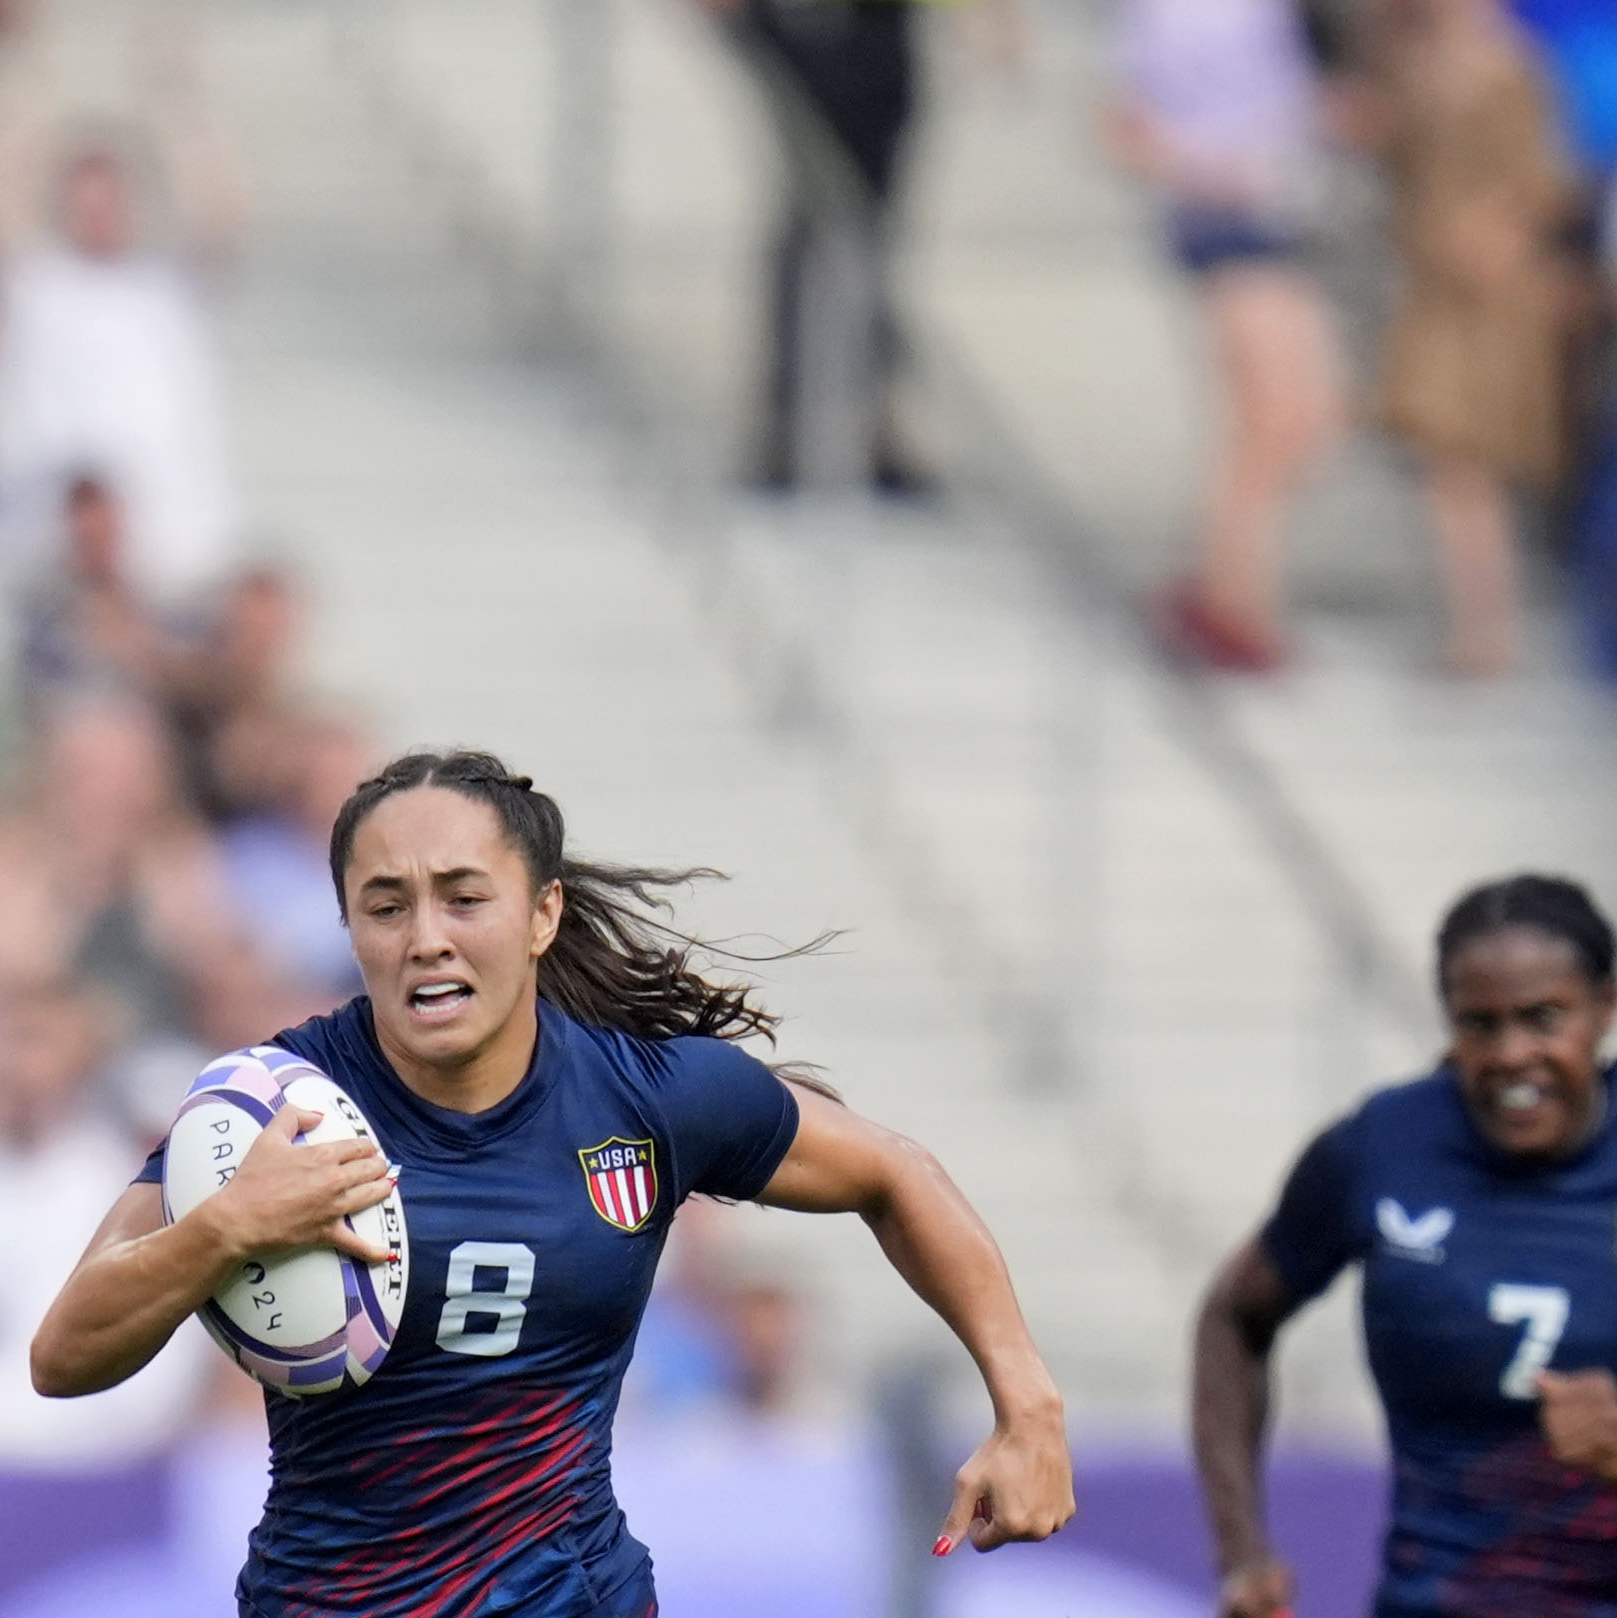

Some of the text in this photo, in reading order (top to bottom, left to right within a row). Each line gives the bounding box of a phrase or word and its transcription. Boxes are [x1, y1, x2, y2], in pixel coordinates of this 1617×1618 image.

[336, 1096, 404, 1300] GIERT
[597, 1147, 637, 1170] USA
[242, 1261, 283, 1331] 024
[435, 1241, 536, 1357] 8
[1488, 1281, 1572, 1400] 7
